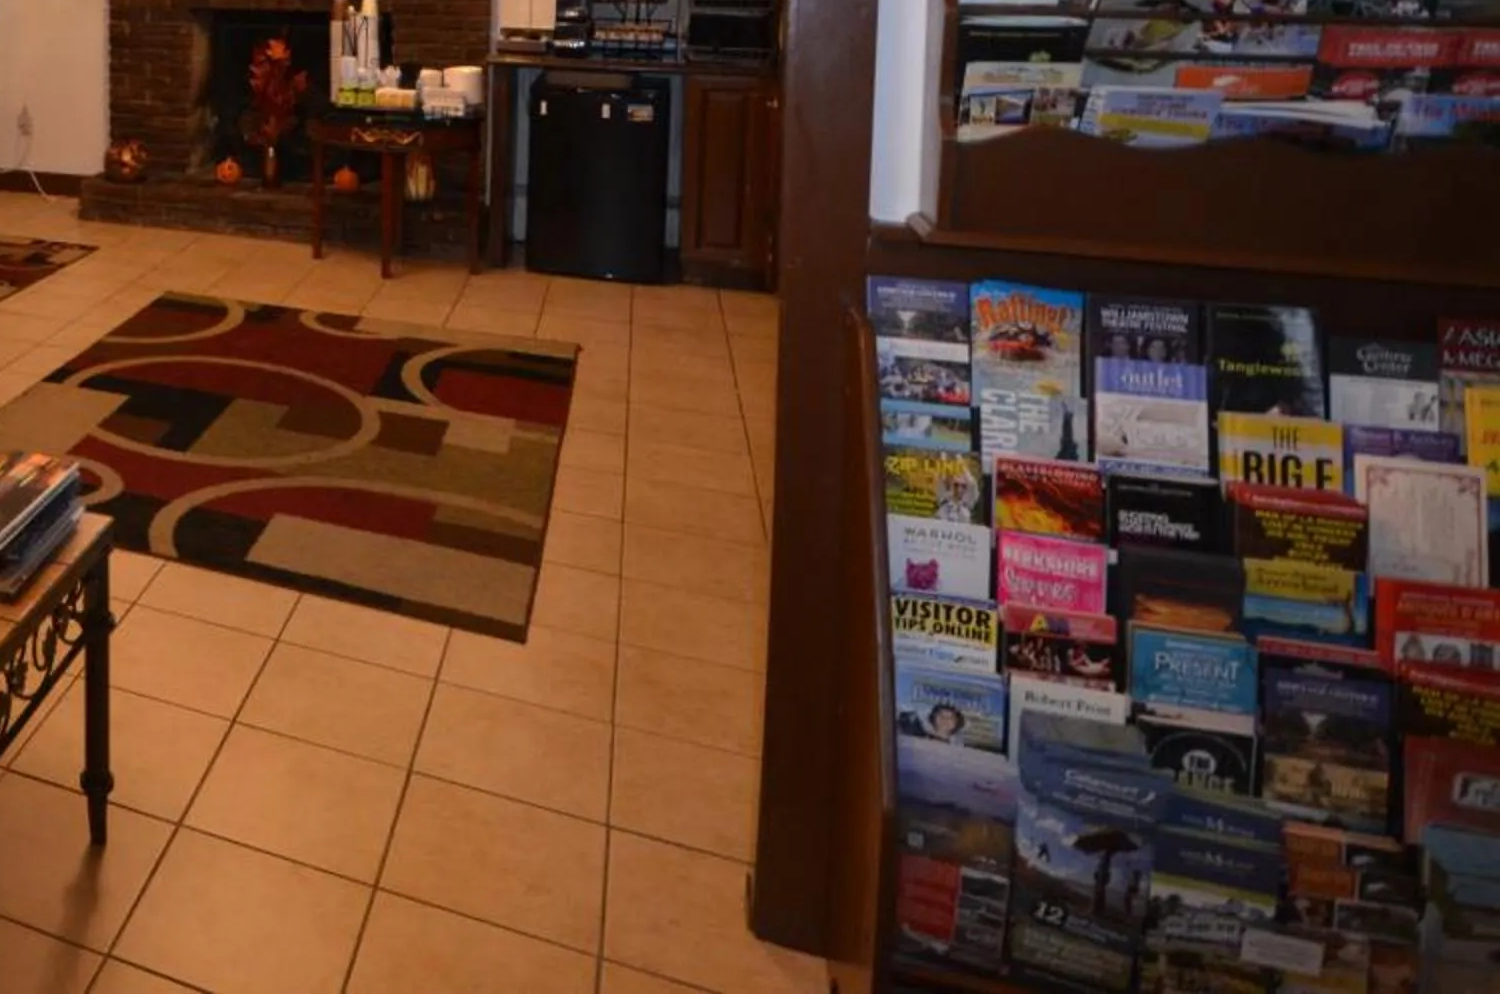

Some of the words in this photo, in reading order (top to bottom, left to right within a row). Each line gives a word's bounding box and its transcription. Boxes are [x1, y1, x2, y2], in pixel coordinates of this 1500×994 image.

[1271, 424, 1299, 451] THE
[1243, 449, 1303, 488] BIG
[904, 526, 977, 545] WARHOL
[895, 600, 991, 629] VISITOR
[894, 618, 927, 632] TIPS
[930, 619, 991, 645] ONLINE
[1155, 651, 1241, 682] PRESENT
[1035, 902, 1065, 925] 12
